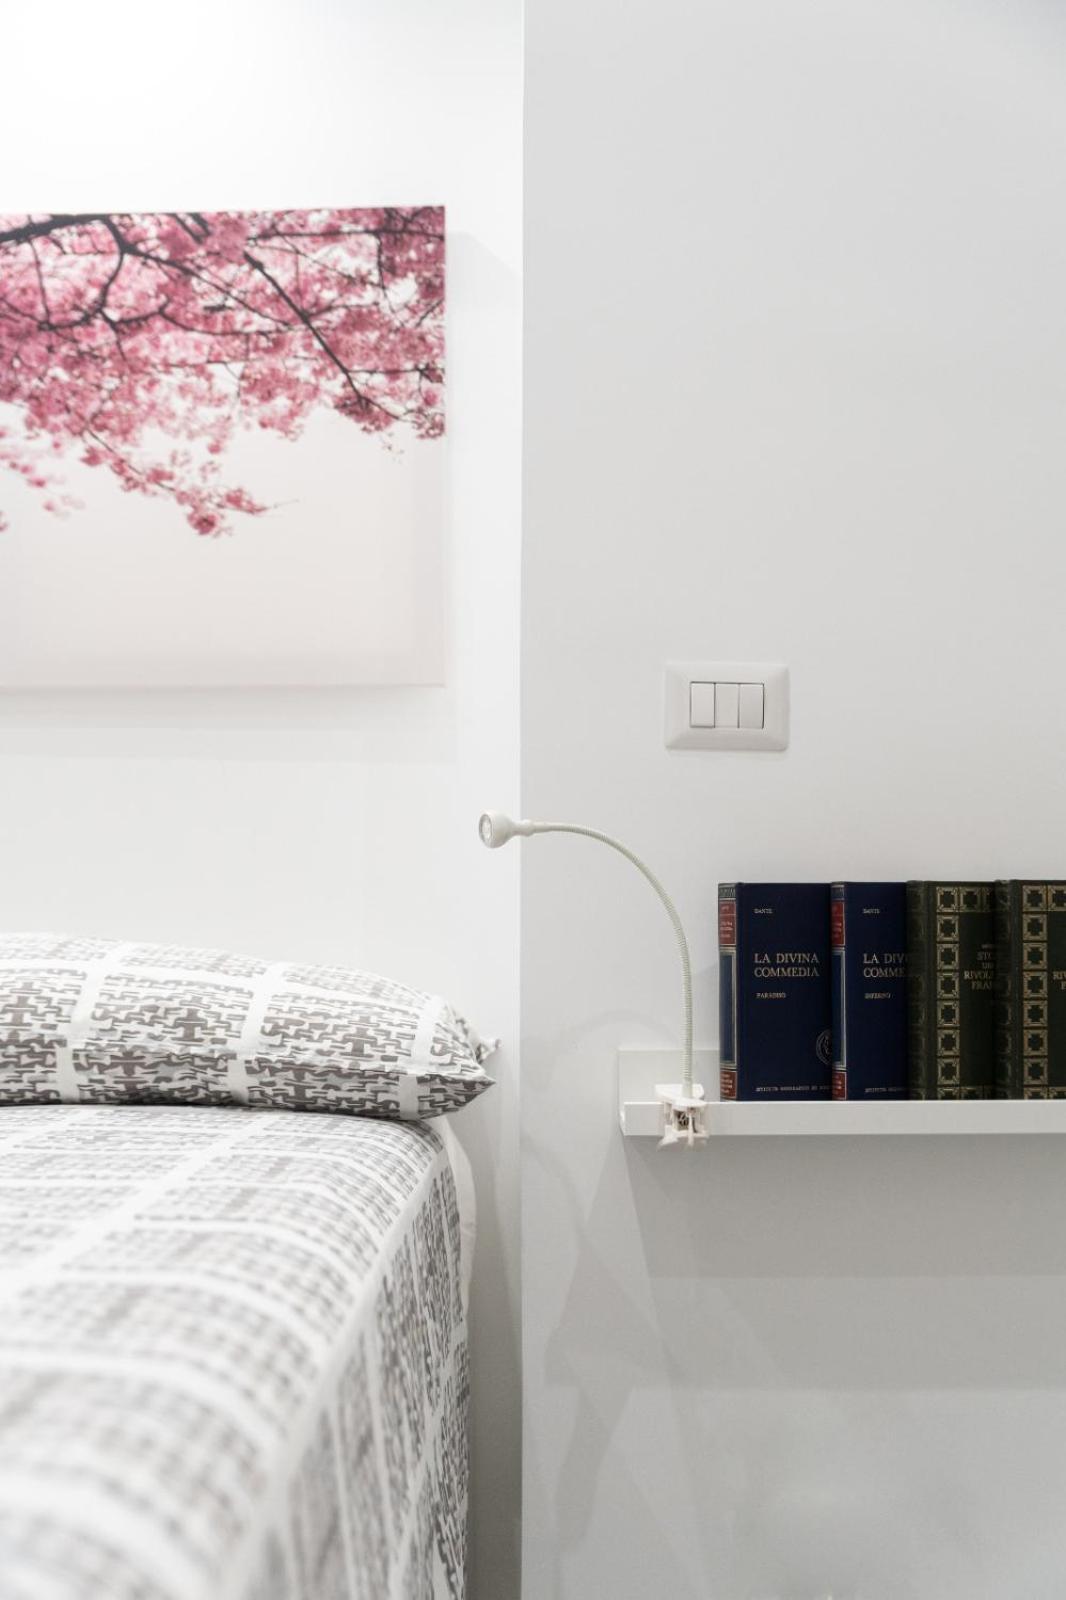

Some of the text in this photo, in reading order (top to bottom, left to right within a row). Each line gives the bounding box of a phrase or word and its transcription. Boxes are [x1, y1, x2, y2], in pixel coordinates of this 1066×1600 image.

[754, 952, 820, 964] LA DIVINA
[863, 952, 880, 964] LA
[754, 967, 820, 978] COMMEDIA
[863, 967, 907, 978] COMME
